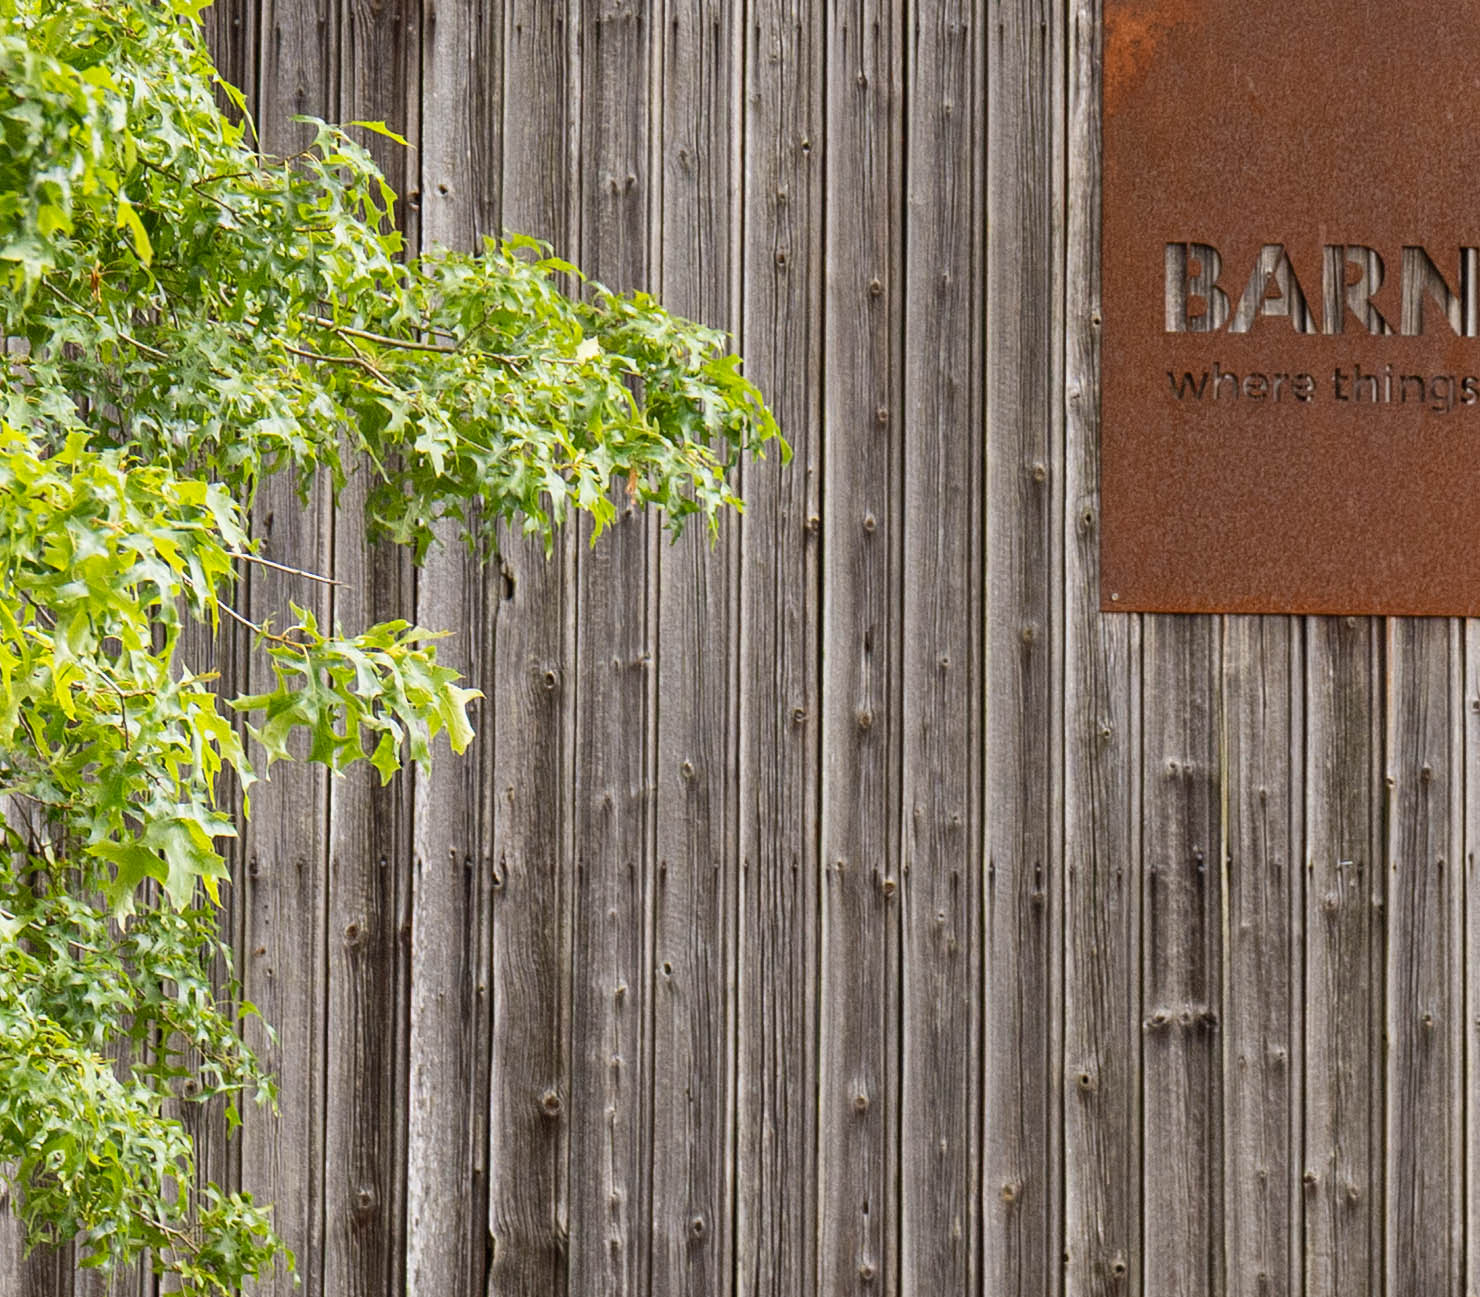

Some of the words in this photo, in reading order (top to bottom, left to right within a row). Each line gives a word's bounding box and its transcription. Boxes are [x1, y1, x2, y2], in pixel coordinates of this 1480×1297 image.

[1165, 242, 1479, 336] BARN
[1167, 362, 1316, 403] where
[1331, 363, 1480, 413] things
